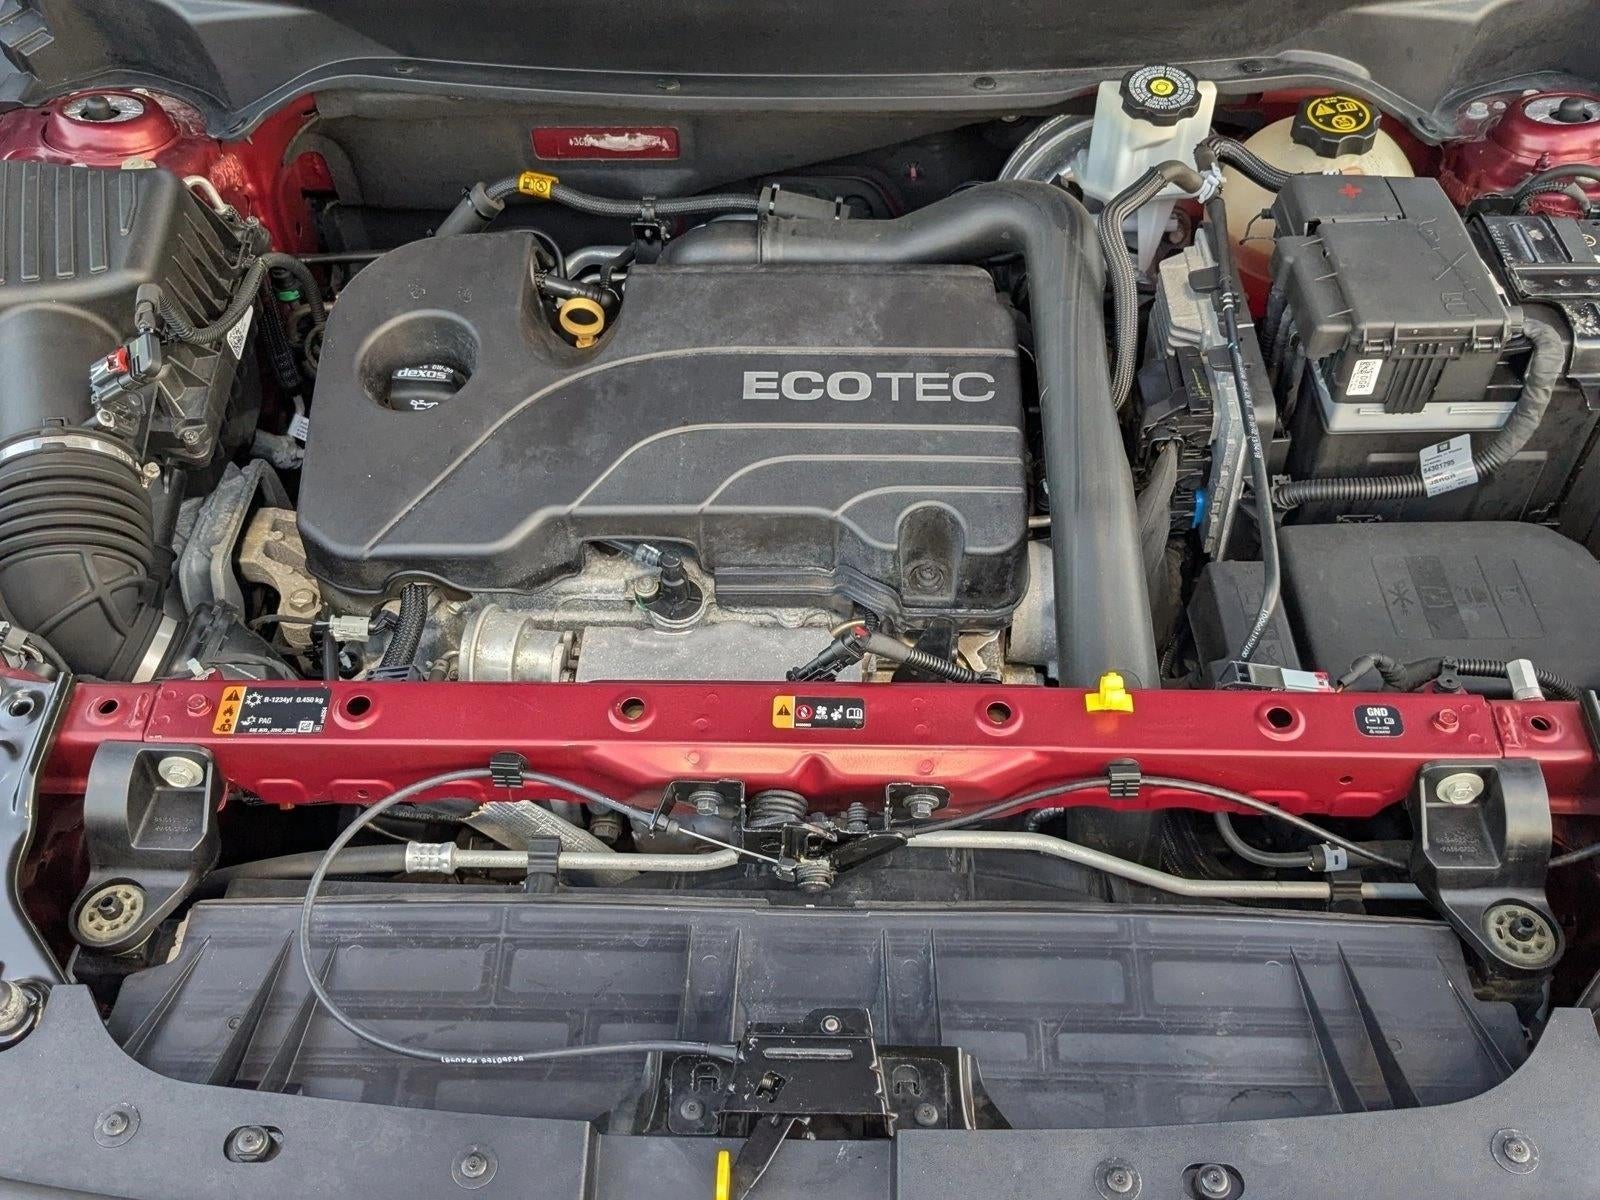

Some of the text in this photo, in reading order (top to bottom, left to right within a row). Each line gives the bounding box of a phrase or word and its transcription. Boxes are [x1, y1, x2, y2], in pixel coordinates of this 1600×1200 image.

[397, 368, 447, 379] dexos
[743, 370, 996, 402] ECOTEC
[296, 696, 314, 704] 0.450
[315, 696, 324, 705] kg
[1366, 707, 1389, 717] GND
